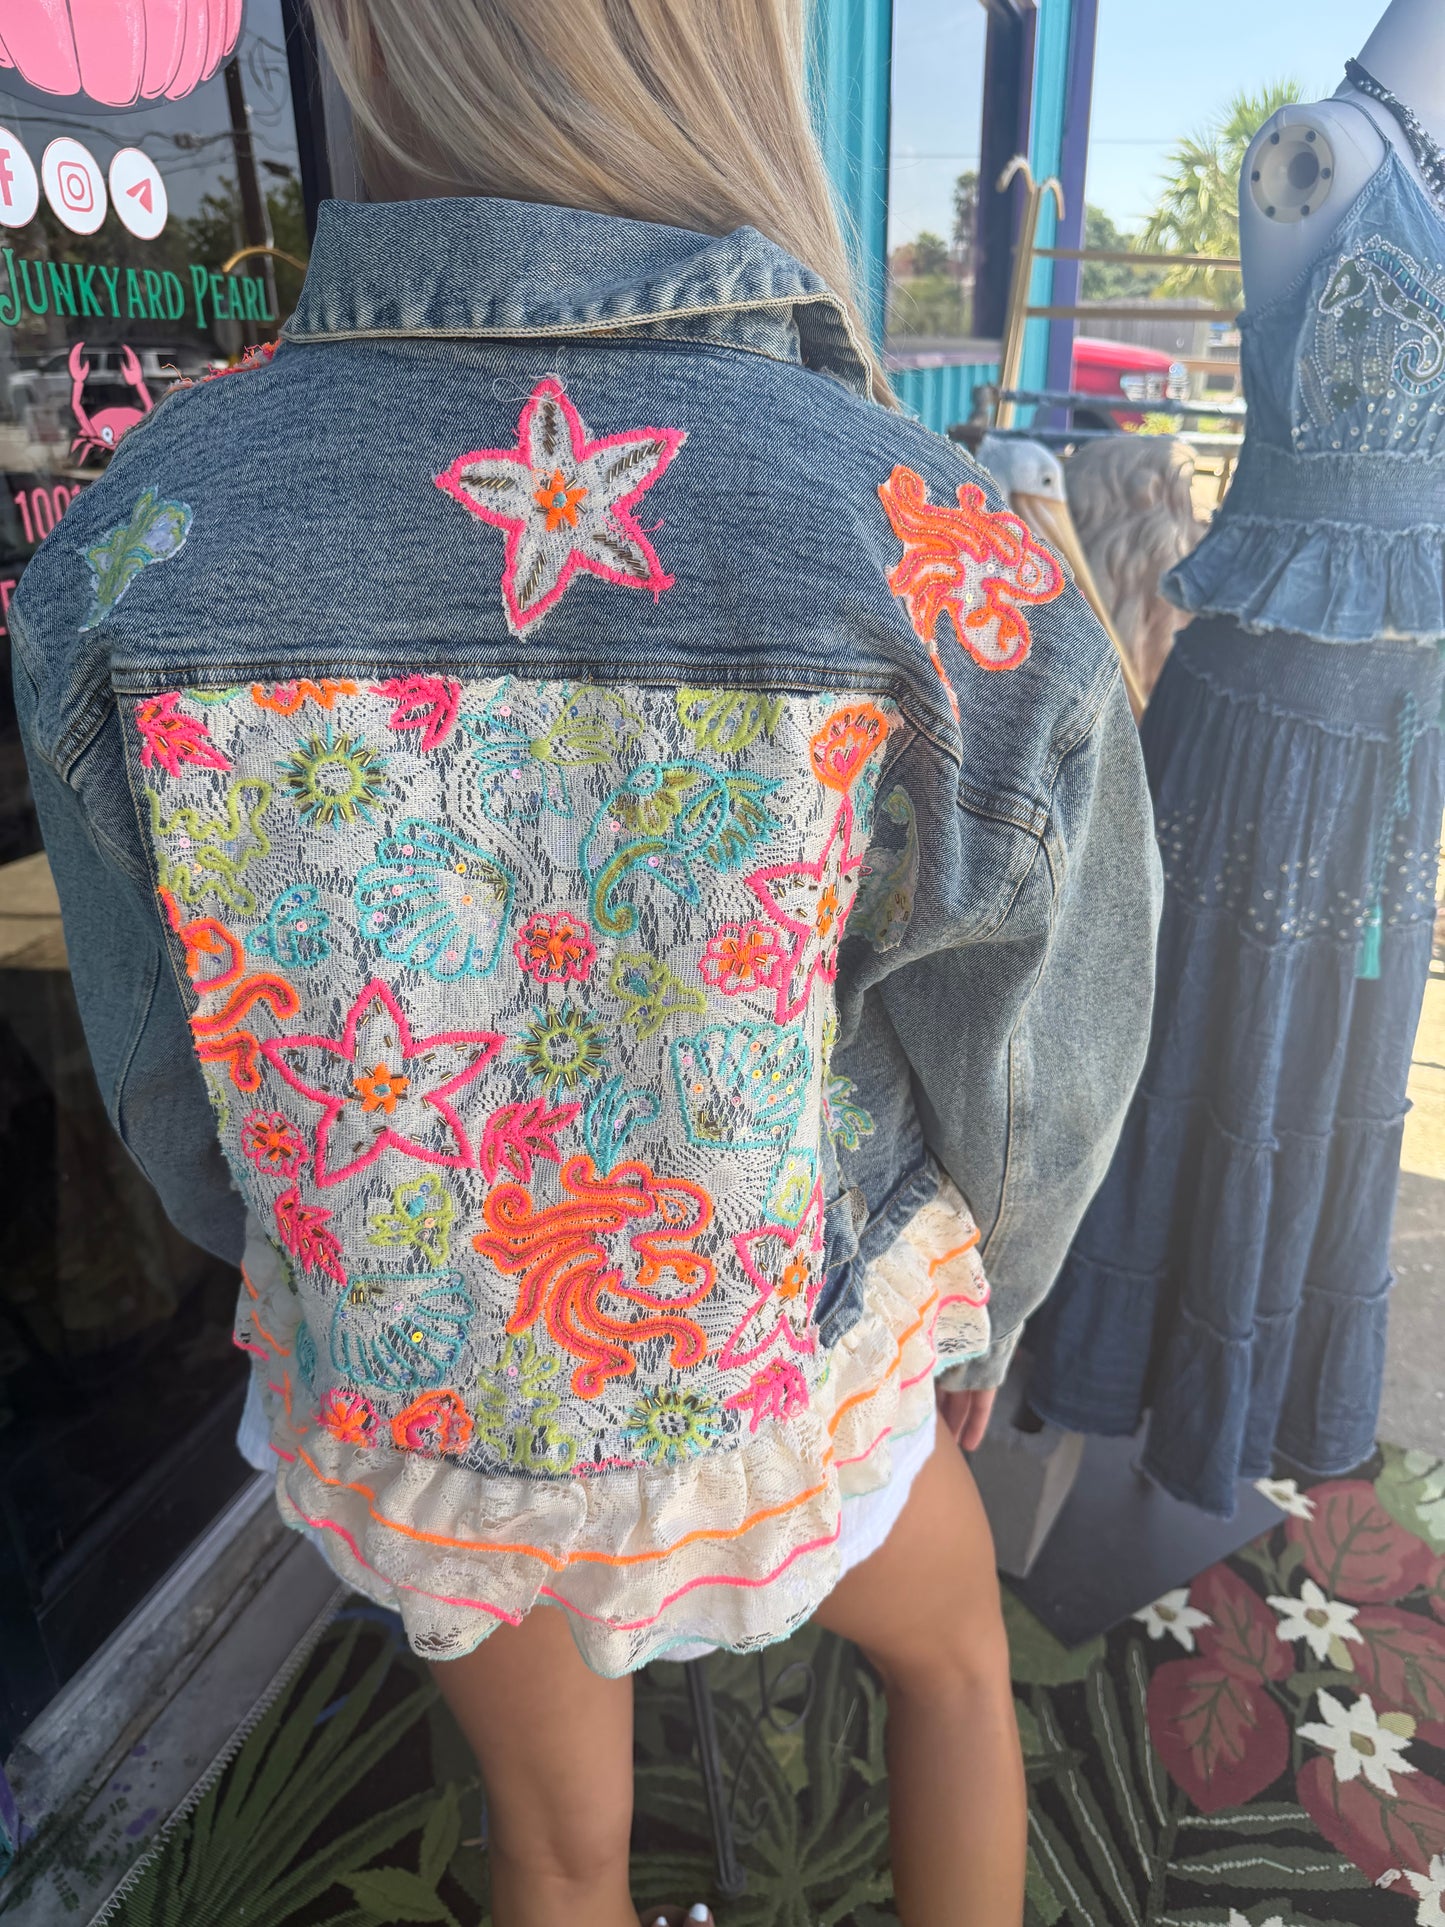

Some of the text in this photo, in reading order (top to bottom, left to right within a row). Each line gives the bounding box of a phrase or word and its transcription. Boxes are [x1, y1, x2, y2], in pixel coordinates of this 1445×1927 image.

[0, 248, 276, 329] JUNKYARD PEARL
[14, 484, 82, 544] 100
